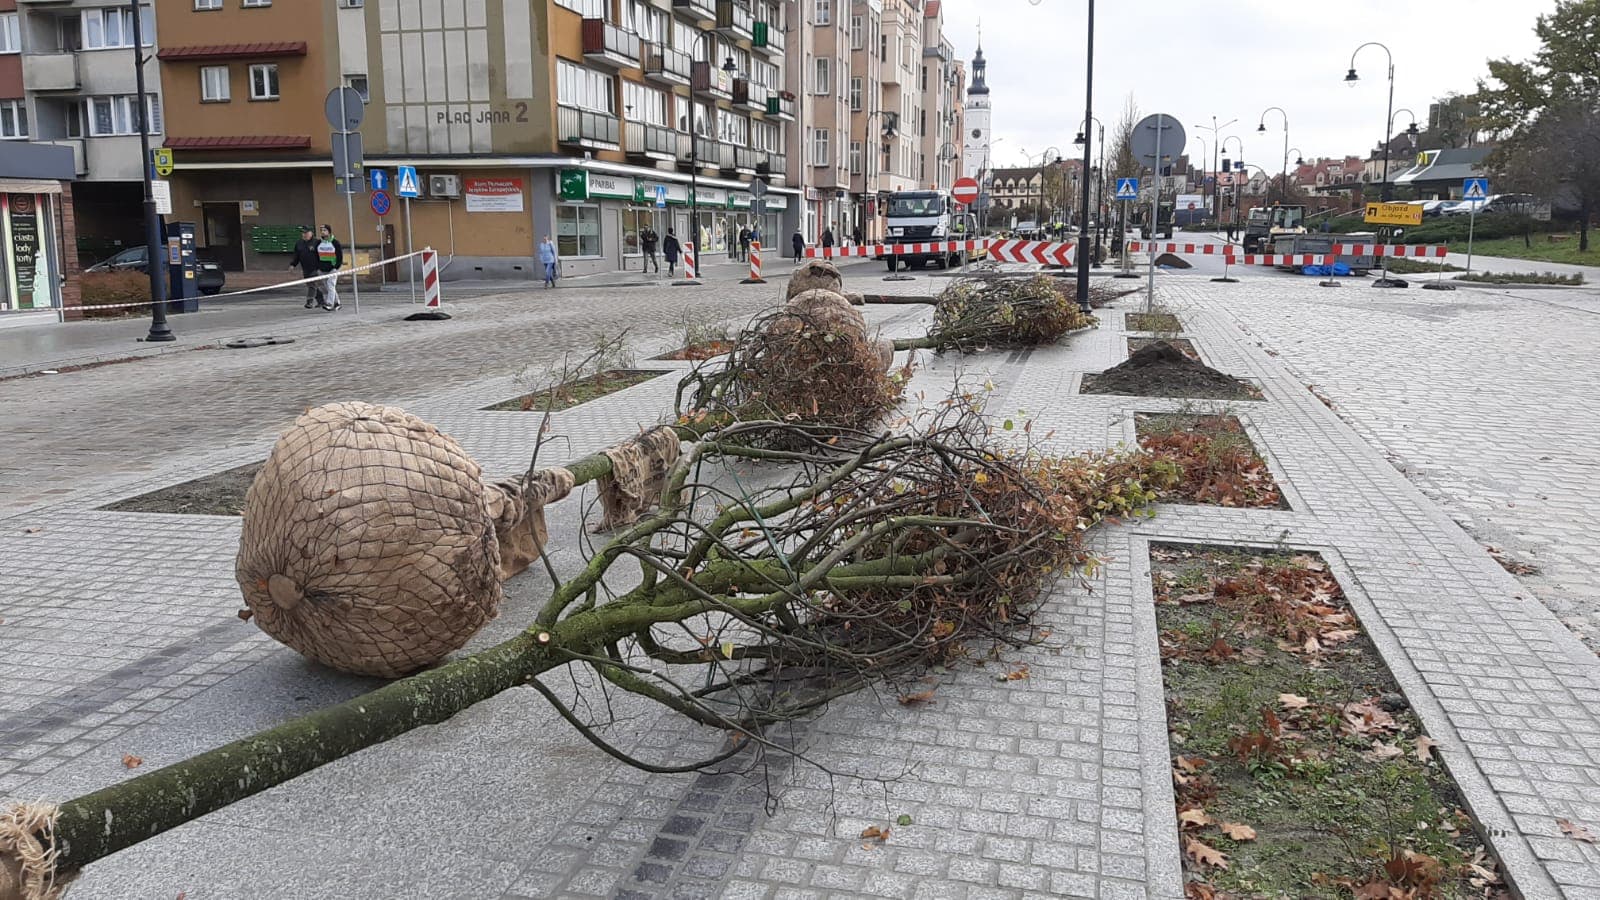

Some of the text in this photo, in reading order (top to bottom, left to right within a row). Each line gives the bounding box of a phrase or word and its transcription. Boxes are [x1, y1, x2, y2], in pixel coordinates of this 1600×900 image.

[437, 102, 529, 124] PLAC JANA 2
[14, 233, 35, 242] ciasta
[16, 243, 32, 254] lody
[16, 255, 33, 264] torty
